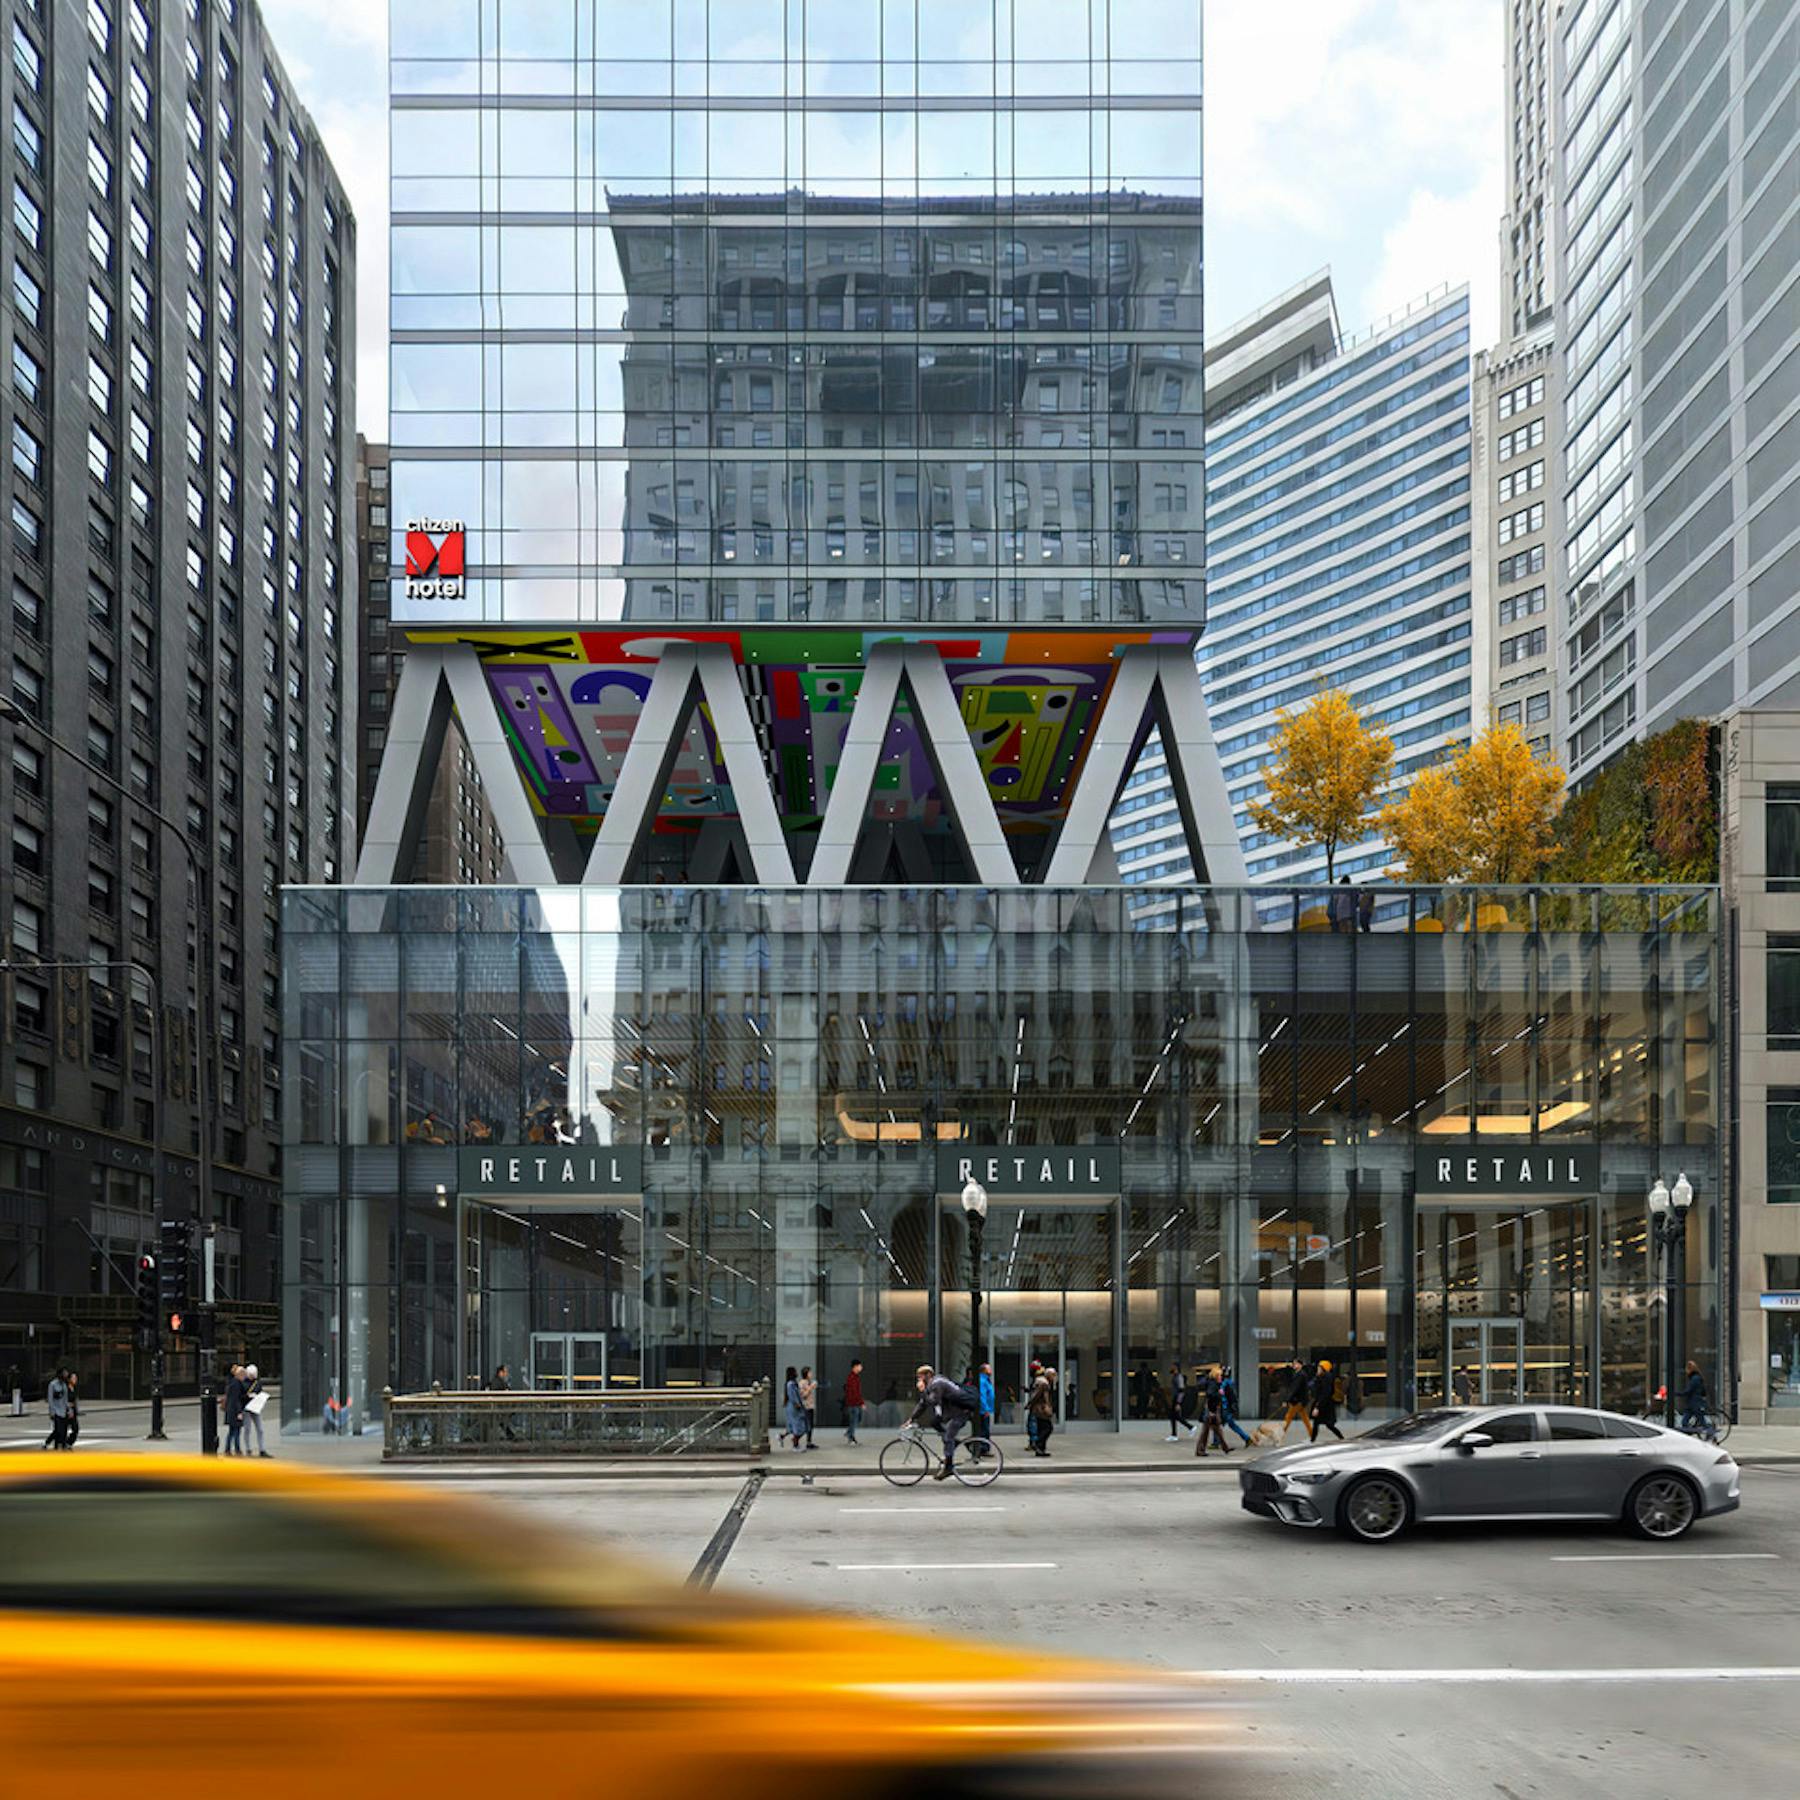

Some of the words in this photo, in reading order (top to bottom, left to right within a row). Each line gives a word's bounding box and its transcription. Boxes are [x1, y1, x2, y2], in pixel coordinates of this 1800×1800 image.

[405, 516, 465, 532] citizen
[405, 531, 465, 576] M
[405, 575, 465, 598] hotel
[480, 1158, 622, 1183] RETAIL
[958, 1158, 1100, 1183] RETAIL
[1438, 1158, 1580, 1183] RETAIL
